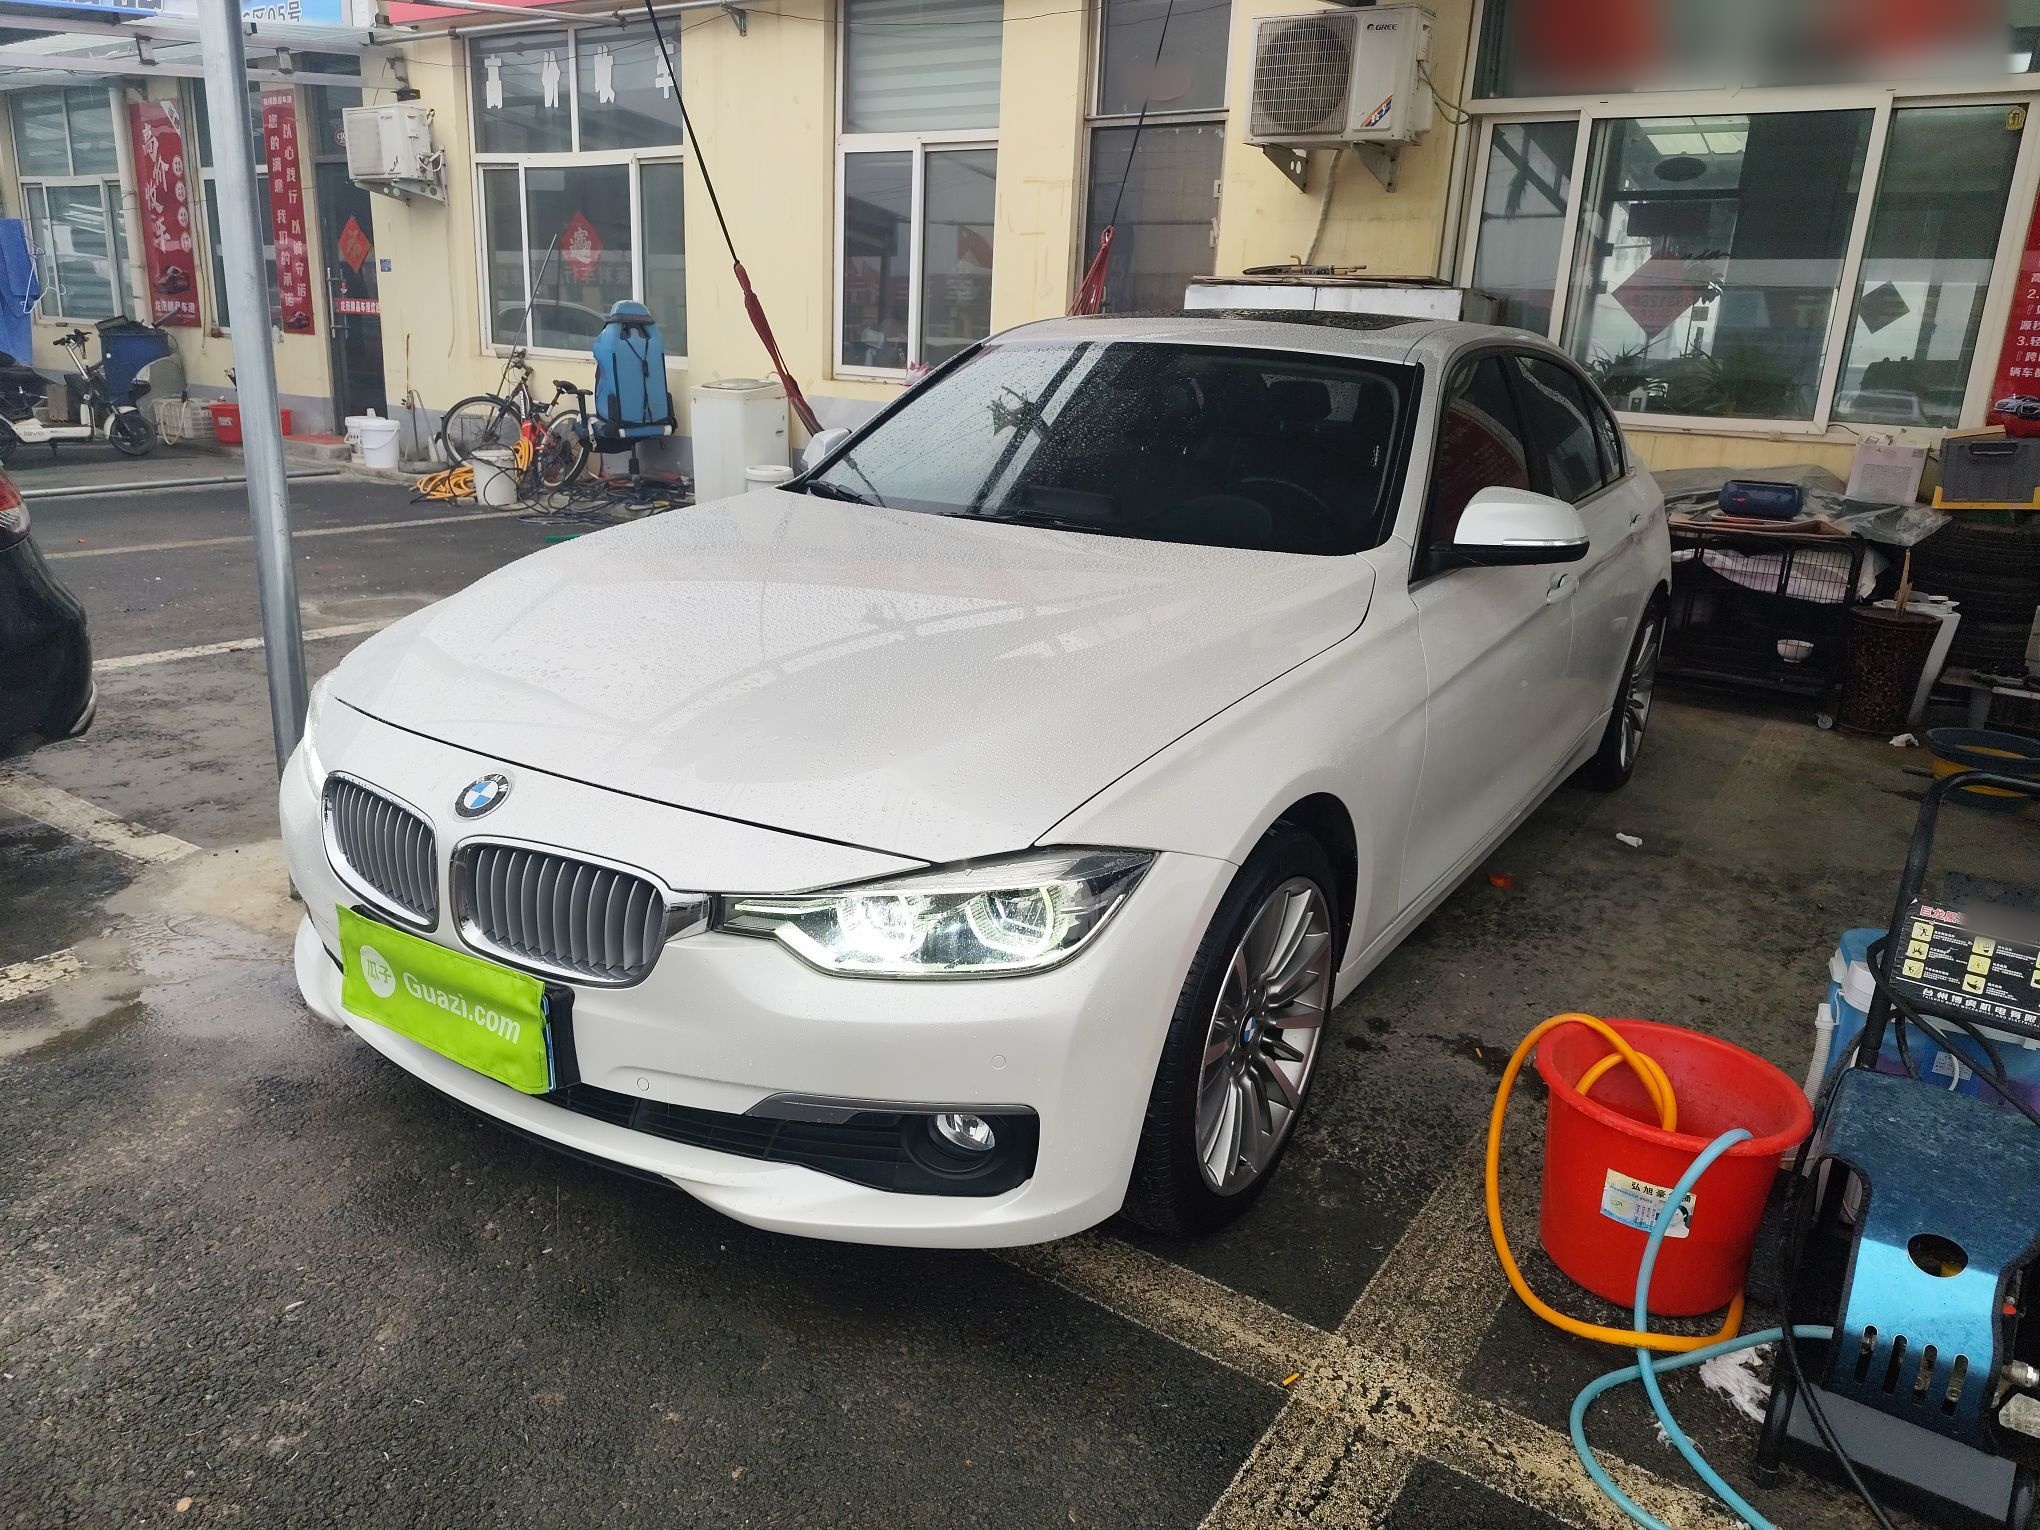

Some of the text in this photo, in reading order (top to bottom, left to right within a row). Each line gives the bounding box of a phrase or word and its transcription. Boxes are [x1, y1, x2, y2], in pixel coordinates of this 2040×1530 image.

[1375, 23, 1398, 31] GREE
[366, 959, 392, 985] 瓜子
[402, 972, 521, 1044] Guazi.com
